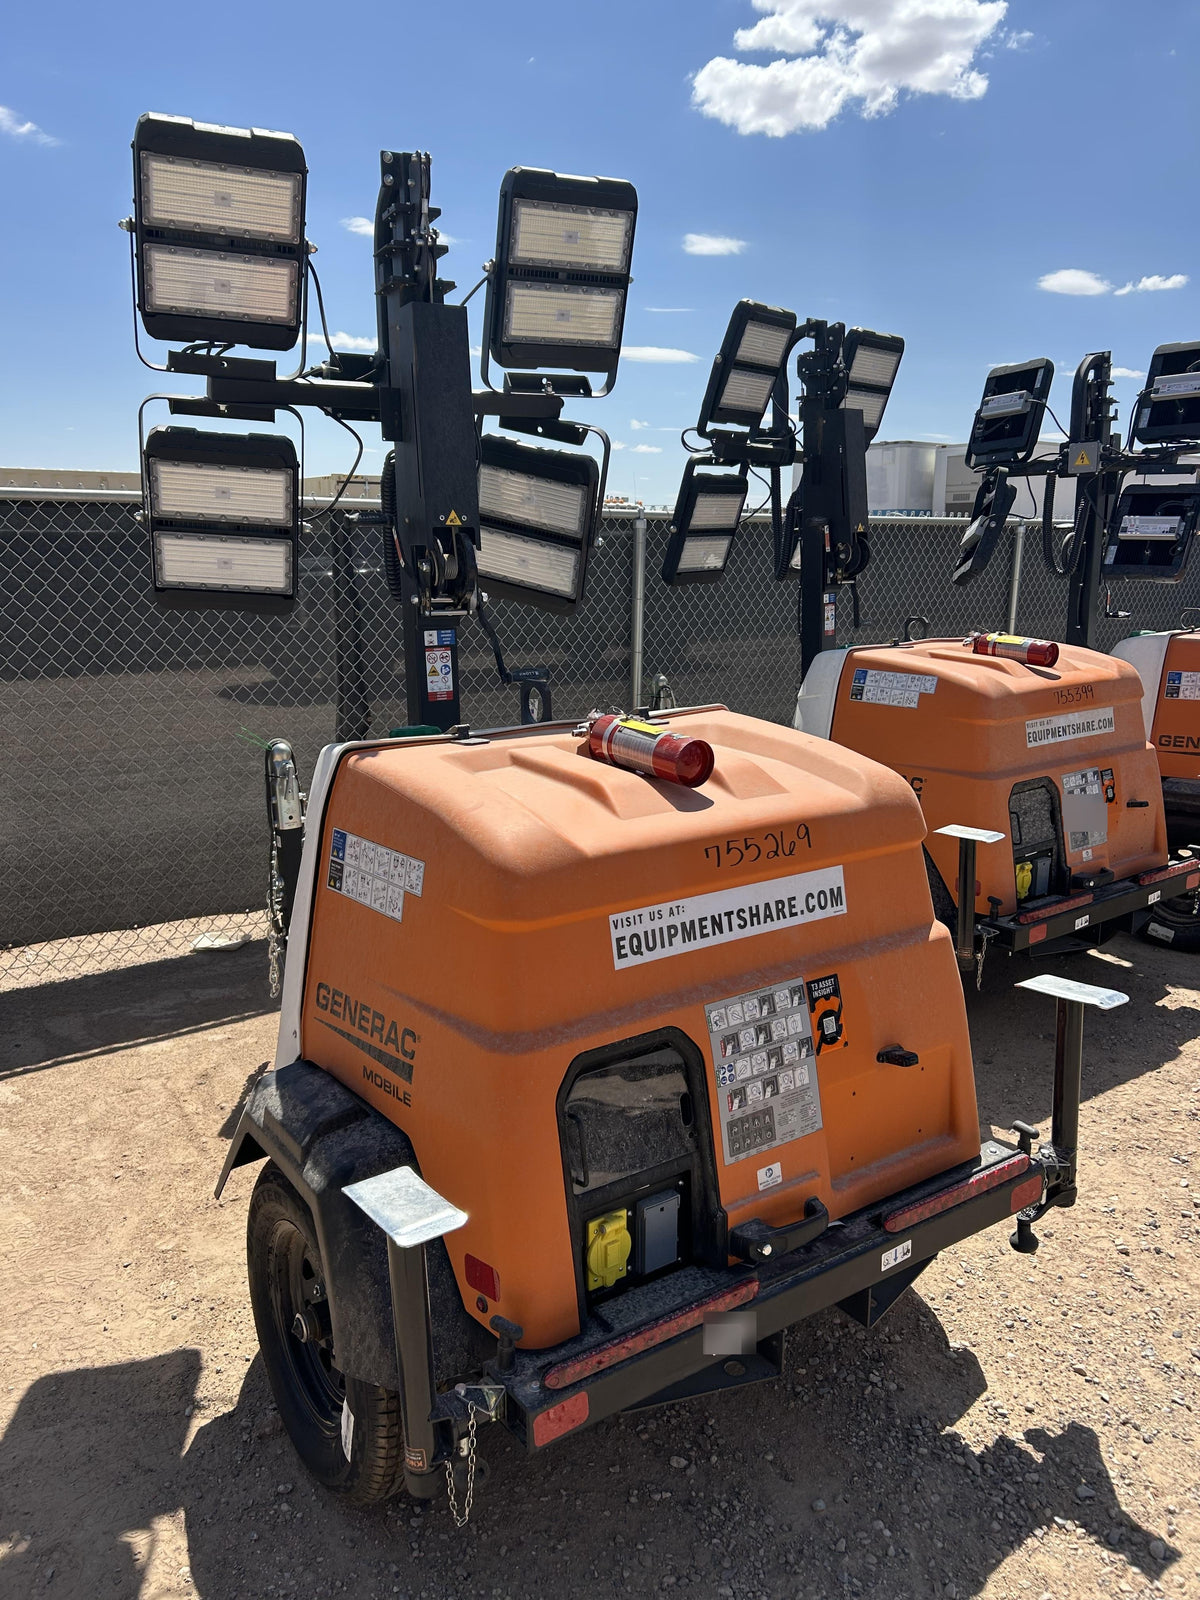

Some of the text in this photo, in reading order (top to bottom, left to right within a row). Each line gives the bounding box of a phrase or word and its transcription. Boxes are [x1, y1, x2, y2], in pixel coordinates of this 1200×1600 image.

[1054, 685, 1094, 704] 755399
[1027, 717, 1114, 743] EQUIPMENTSHARE.COM
[704, 823, 812, 868] 755269
[612, 905, 685, 930] VISIT US AT:
[615, 886, 843, 960] EQUIPMENTSHARE.COM
[811, 978, 835, 991] T3 ASSET
[812, 987, 833, 998] INSIGHT
[315, 982, 416, 1060] GENERAC
[362, 1065, 411, 1108] MOBILE
